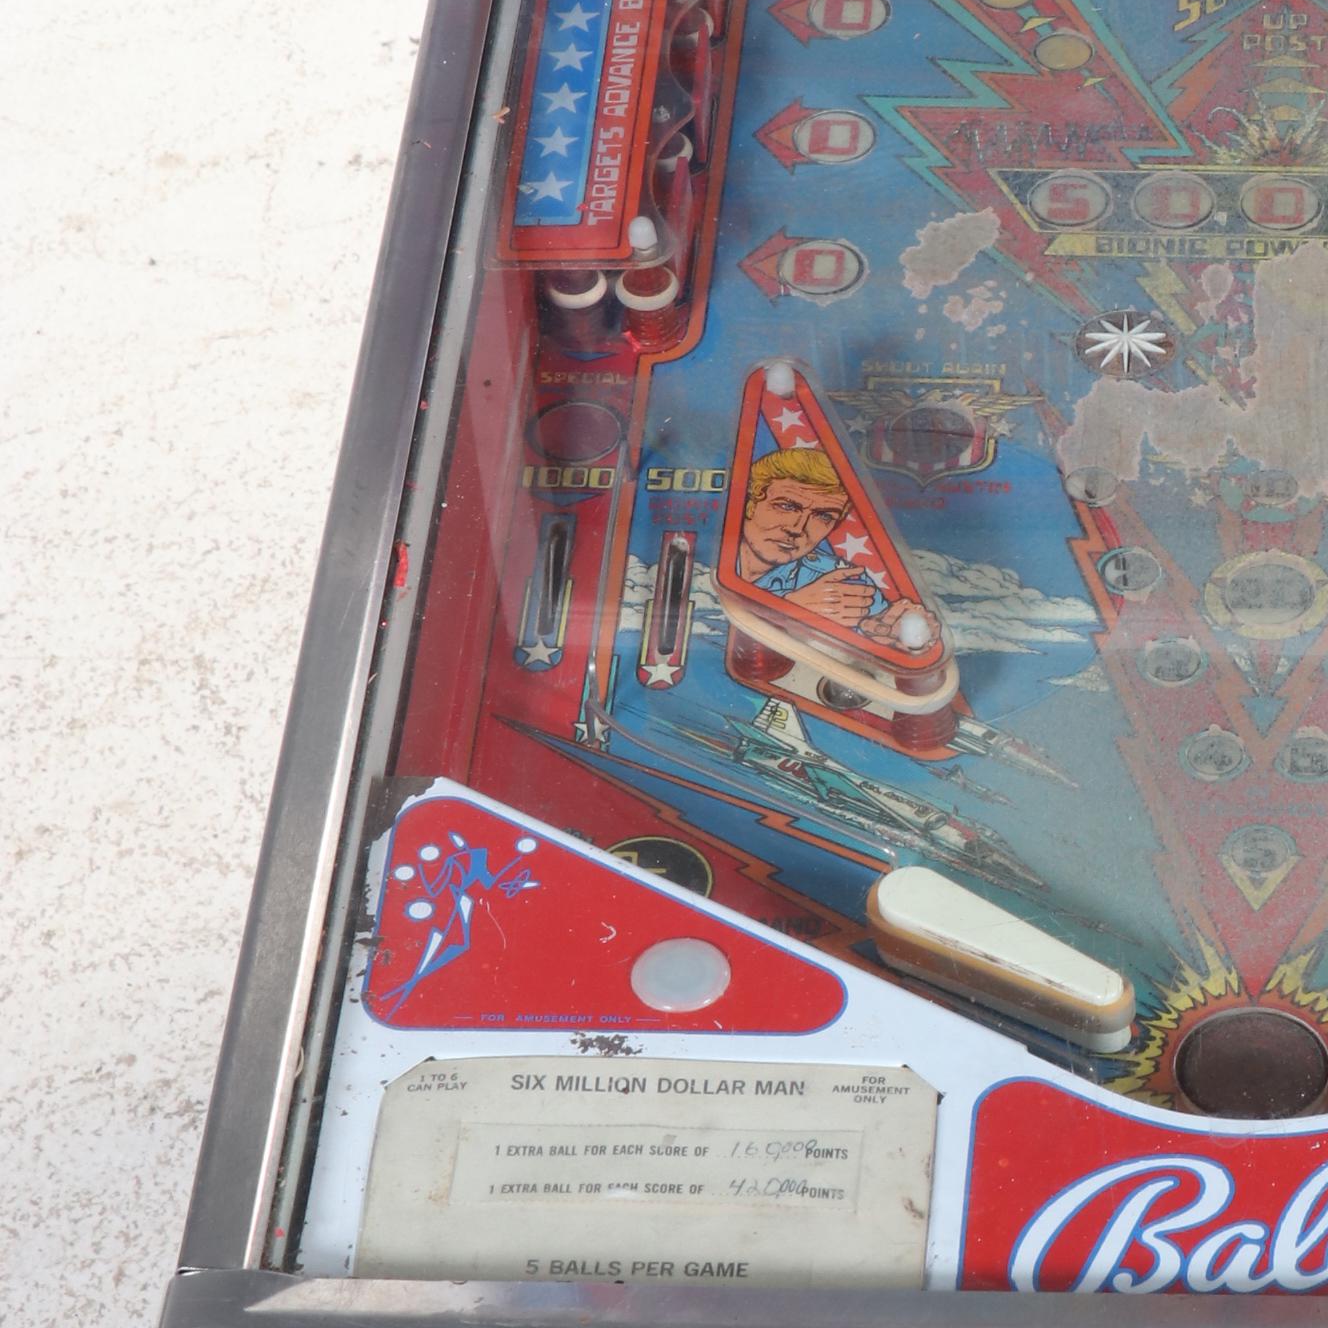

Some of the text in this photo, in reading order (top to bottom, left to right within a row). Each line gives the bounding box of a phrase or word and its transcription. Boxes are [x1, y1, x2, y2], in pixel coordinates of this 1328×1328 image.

[1262, 13, 1307, 30] UP
[1243, 34, 1328, 51] POST
[602, 21, 640, 118] ADVANCE
[588, 127, 625, 226] TARGETS
[522, 466, 616, 489] 1000
[647, 468, 727, 491] 500
[420, 1074, 424, 1082] 1
[450, 1073, 458, 1081] 6
[511, 1074, 805, 1096] SIX MILLION DOLLAR MAN
[862, 1076, 885, 1085] FOR
[408, 1082, 467, 1092] CAN PLAY
[832, 1085, 910, 1095] AMUSEMENT
[853, 1095, 887, 1104] ONLY
[495, 1145, 500, 1156] 1
[507, 1145, 544, 1157] EXTRA
[550, 1145, 577, 1156] BALL
[584, 1145, 606, 1155] FOR
[612, 1144, 643, 1155] EACH
[694, 1146, 709, 1157] OF
[805, 1148, 848, 1160] POINTS
[490, 1184, 495, 1194] 1
[501, 1184, 537, 1193] EXTRA
[544, 1183, 571, 1193] BALL
[578, 1183, 601, 1193] FOR
[645, 1183, 683, 1194] SCORE
[689, 1184, 704, 1194] OF
[801, 1187, 844, 1200] POINTS
[526, 1259, 748, 1278] 5 BALLS PER GAME
